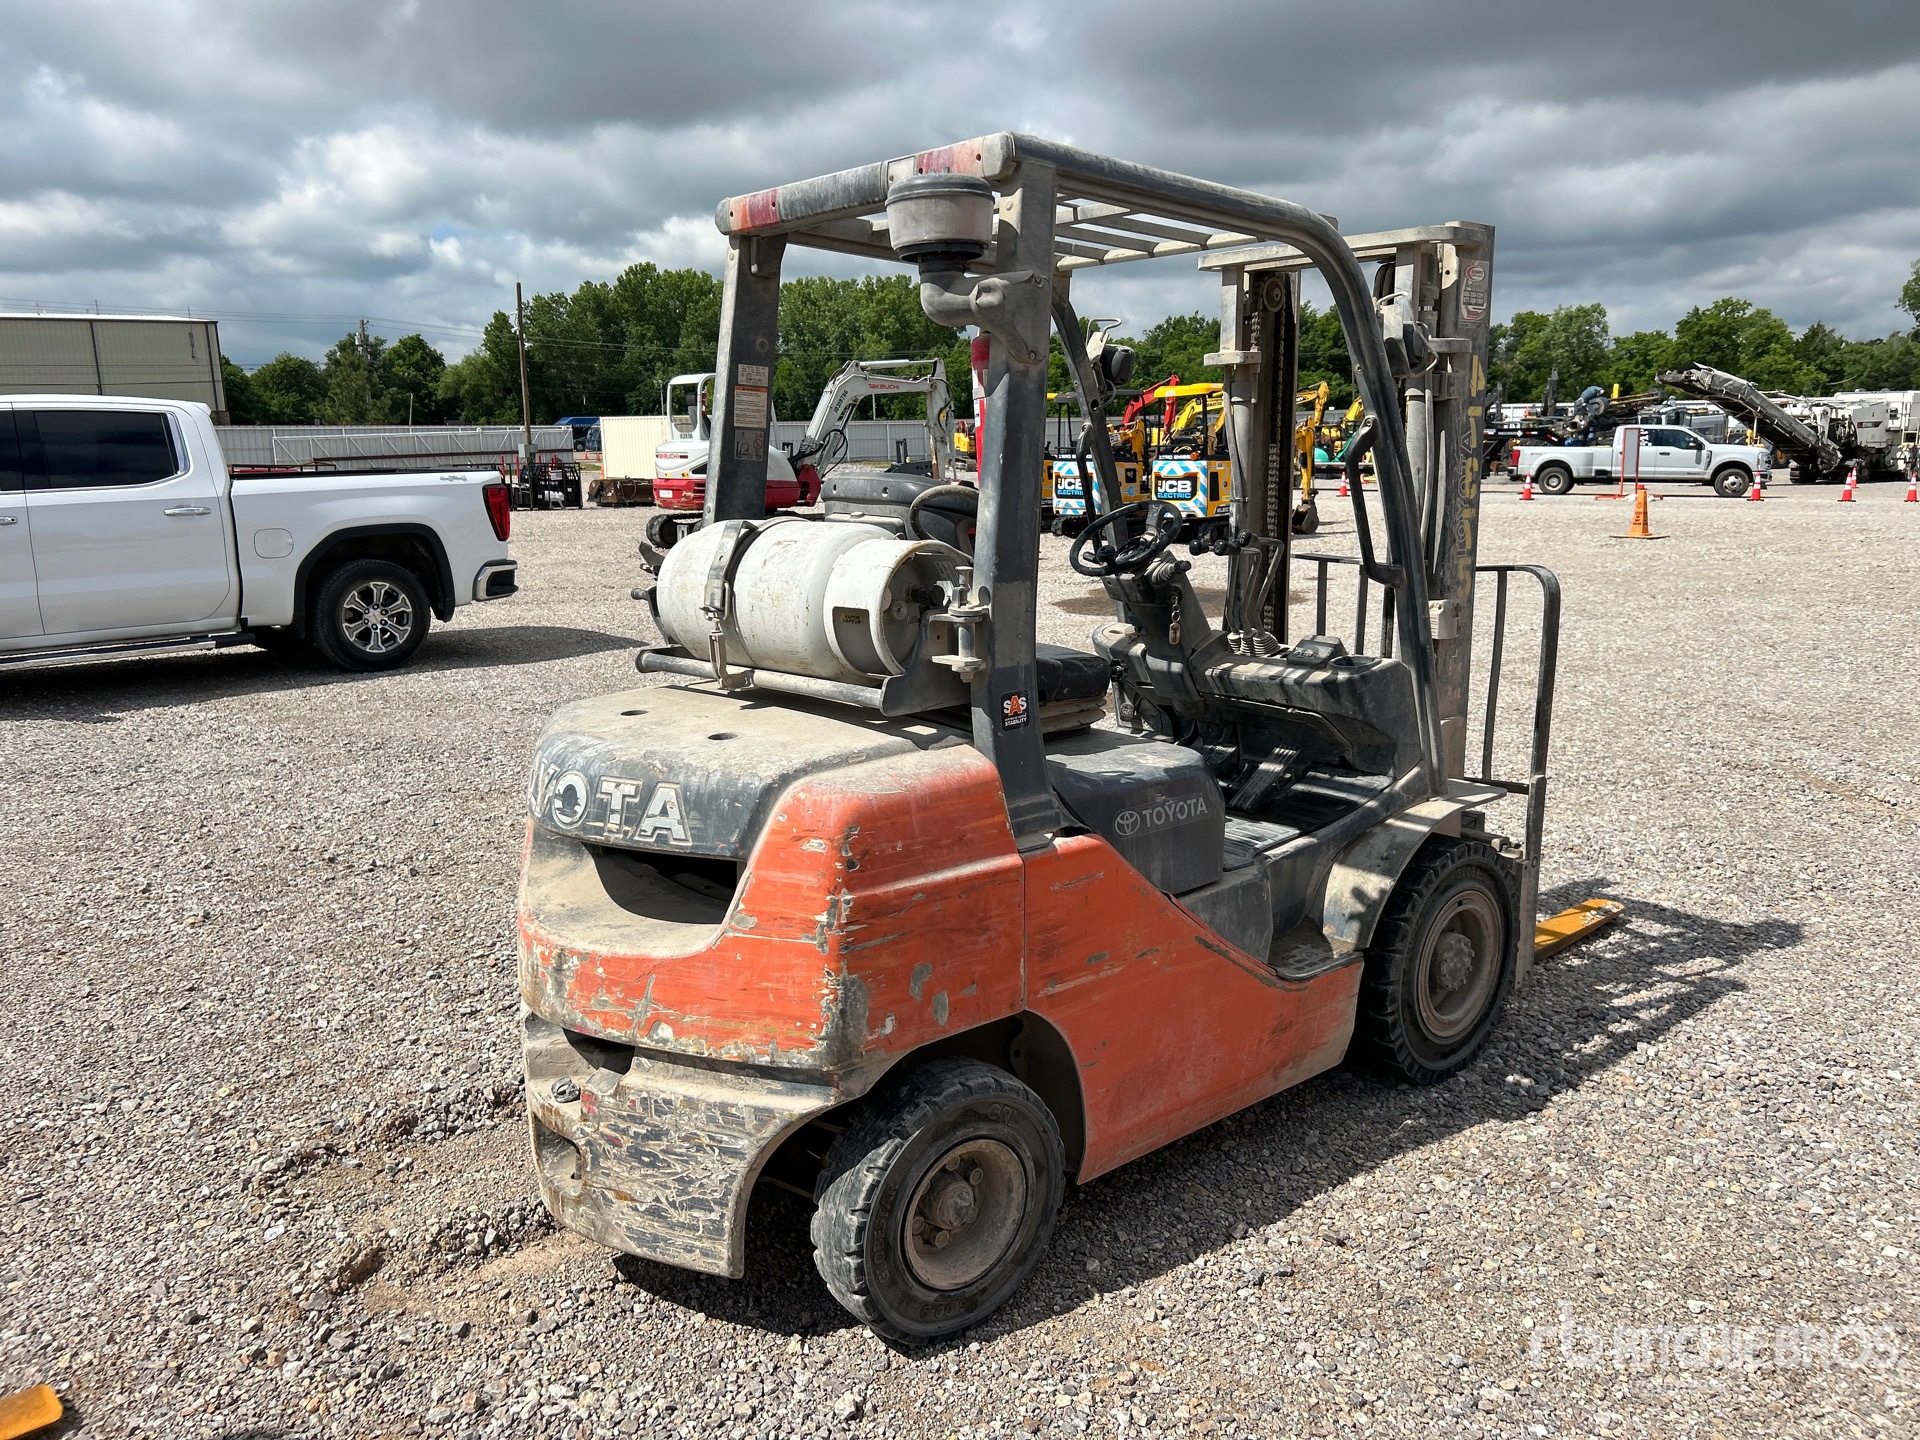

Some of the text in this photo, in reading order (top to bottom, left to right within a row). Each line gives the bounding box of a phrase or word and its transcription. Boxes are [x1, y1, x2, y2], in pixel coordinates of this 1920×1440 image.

[1157, 481, 1192, 493] JCB
[1003, 695, 1027, 716] SAS
[1142, 797, 1208, 828] TOYOTA
